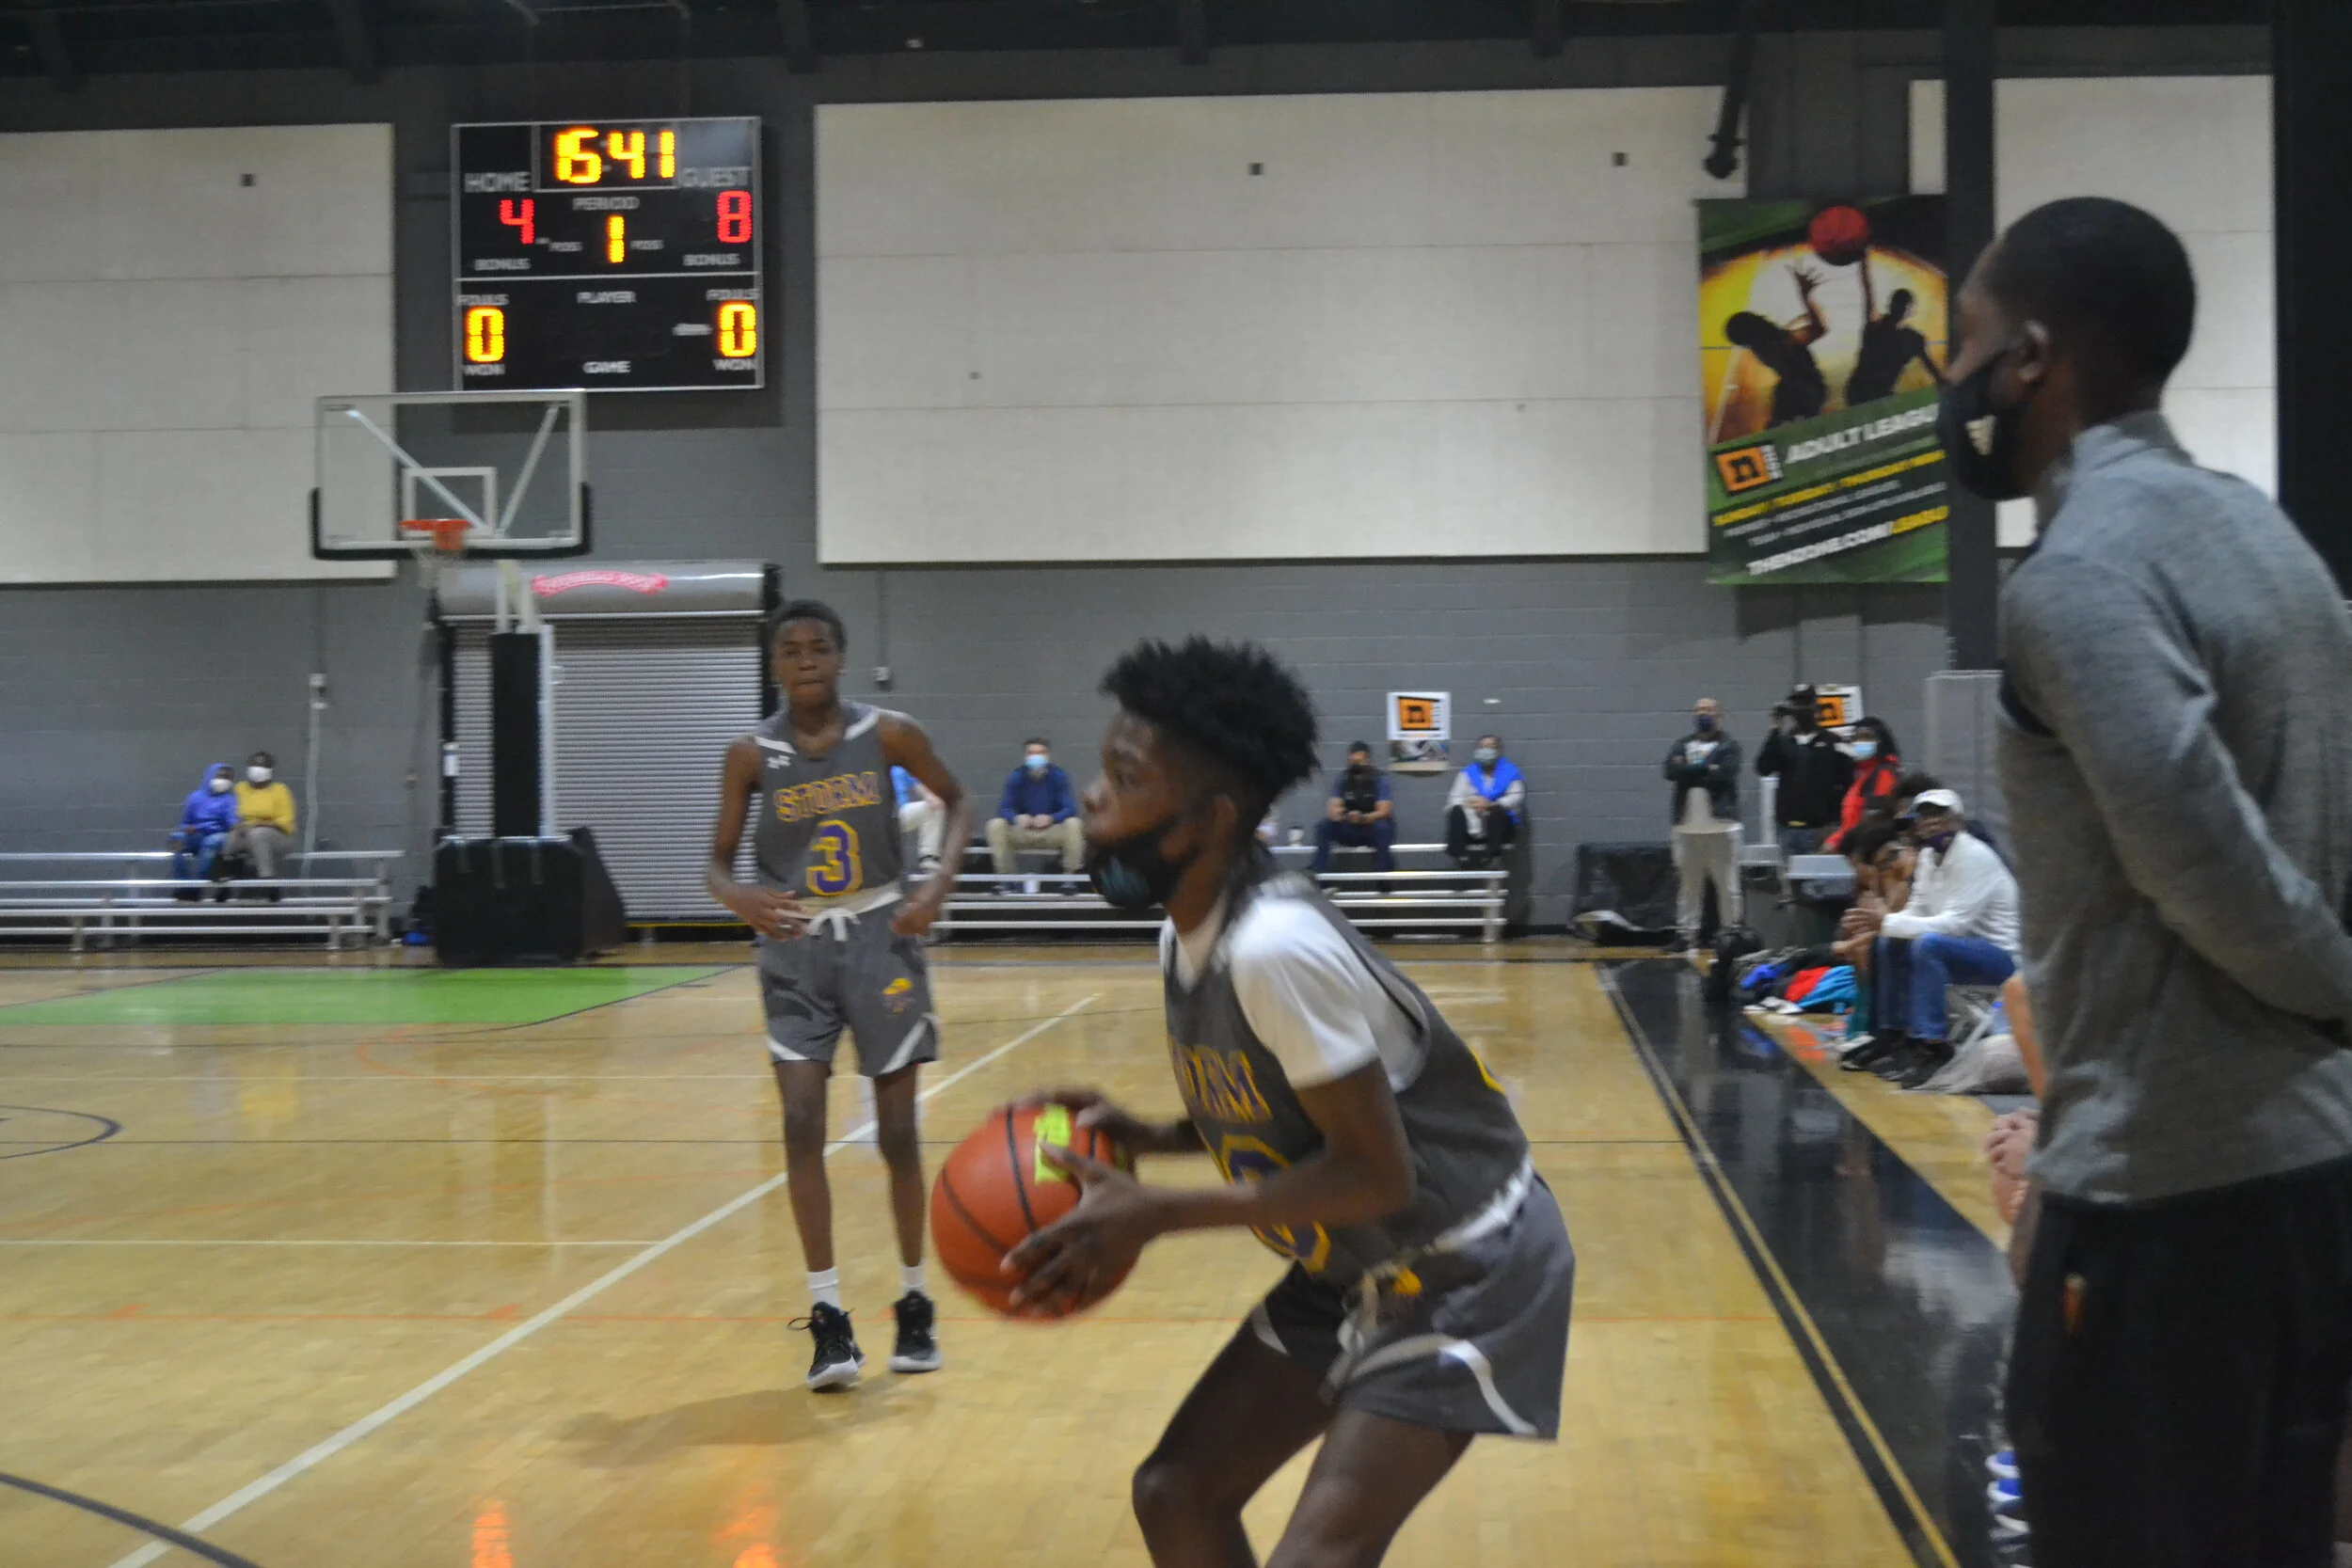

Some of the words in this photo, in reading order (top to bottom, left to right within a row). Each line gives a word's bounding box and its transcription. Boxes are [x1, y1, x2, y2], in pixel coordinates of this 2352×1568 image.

[465, 171, 531, 192] HOME
[680, 166, 752, 188] GUEST
[500, 198, 534, 244] 4
[572, 197, 641, 211] PERIOD
[717, 190, 752, 243] 8
[608, 215, 625, 263] 1
[473, 258, 531, 271] BONUS
[682, 253, 741, 266] BONUS
[576, 291, 637, 304] PLAYER
[467, 309, 504, 362] 0
[720, 304, 756, 357] 0
[582, 360, 631, 373] GAME
[1785, 427, 1863, 464] ADULT
[773, 770, 882, 824] STORM
[805, 819, 863, 896] 3
